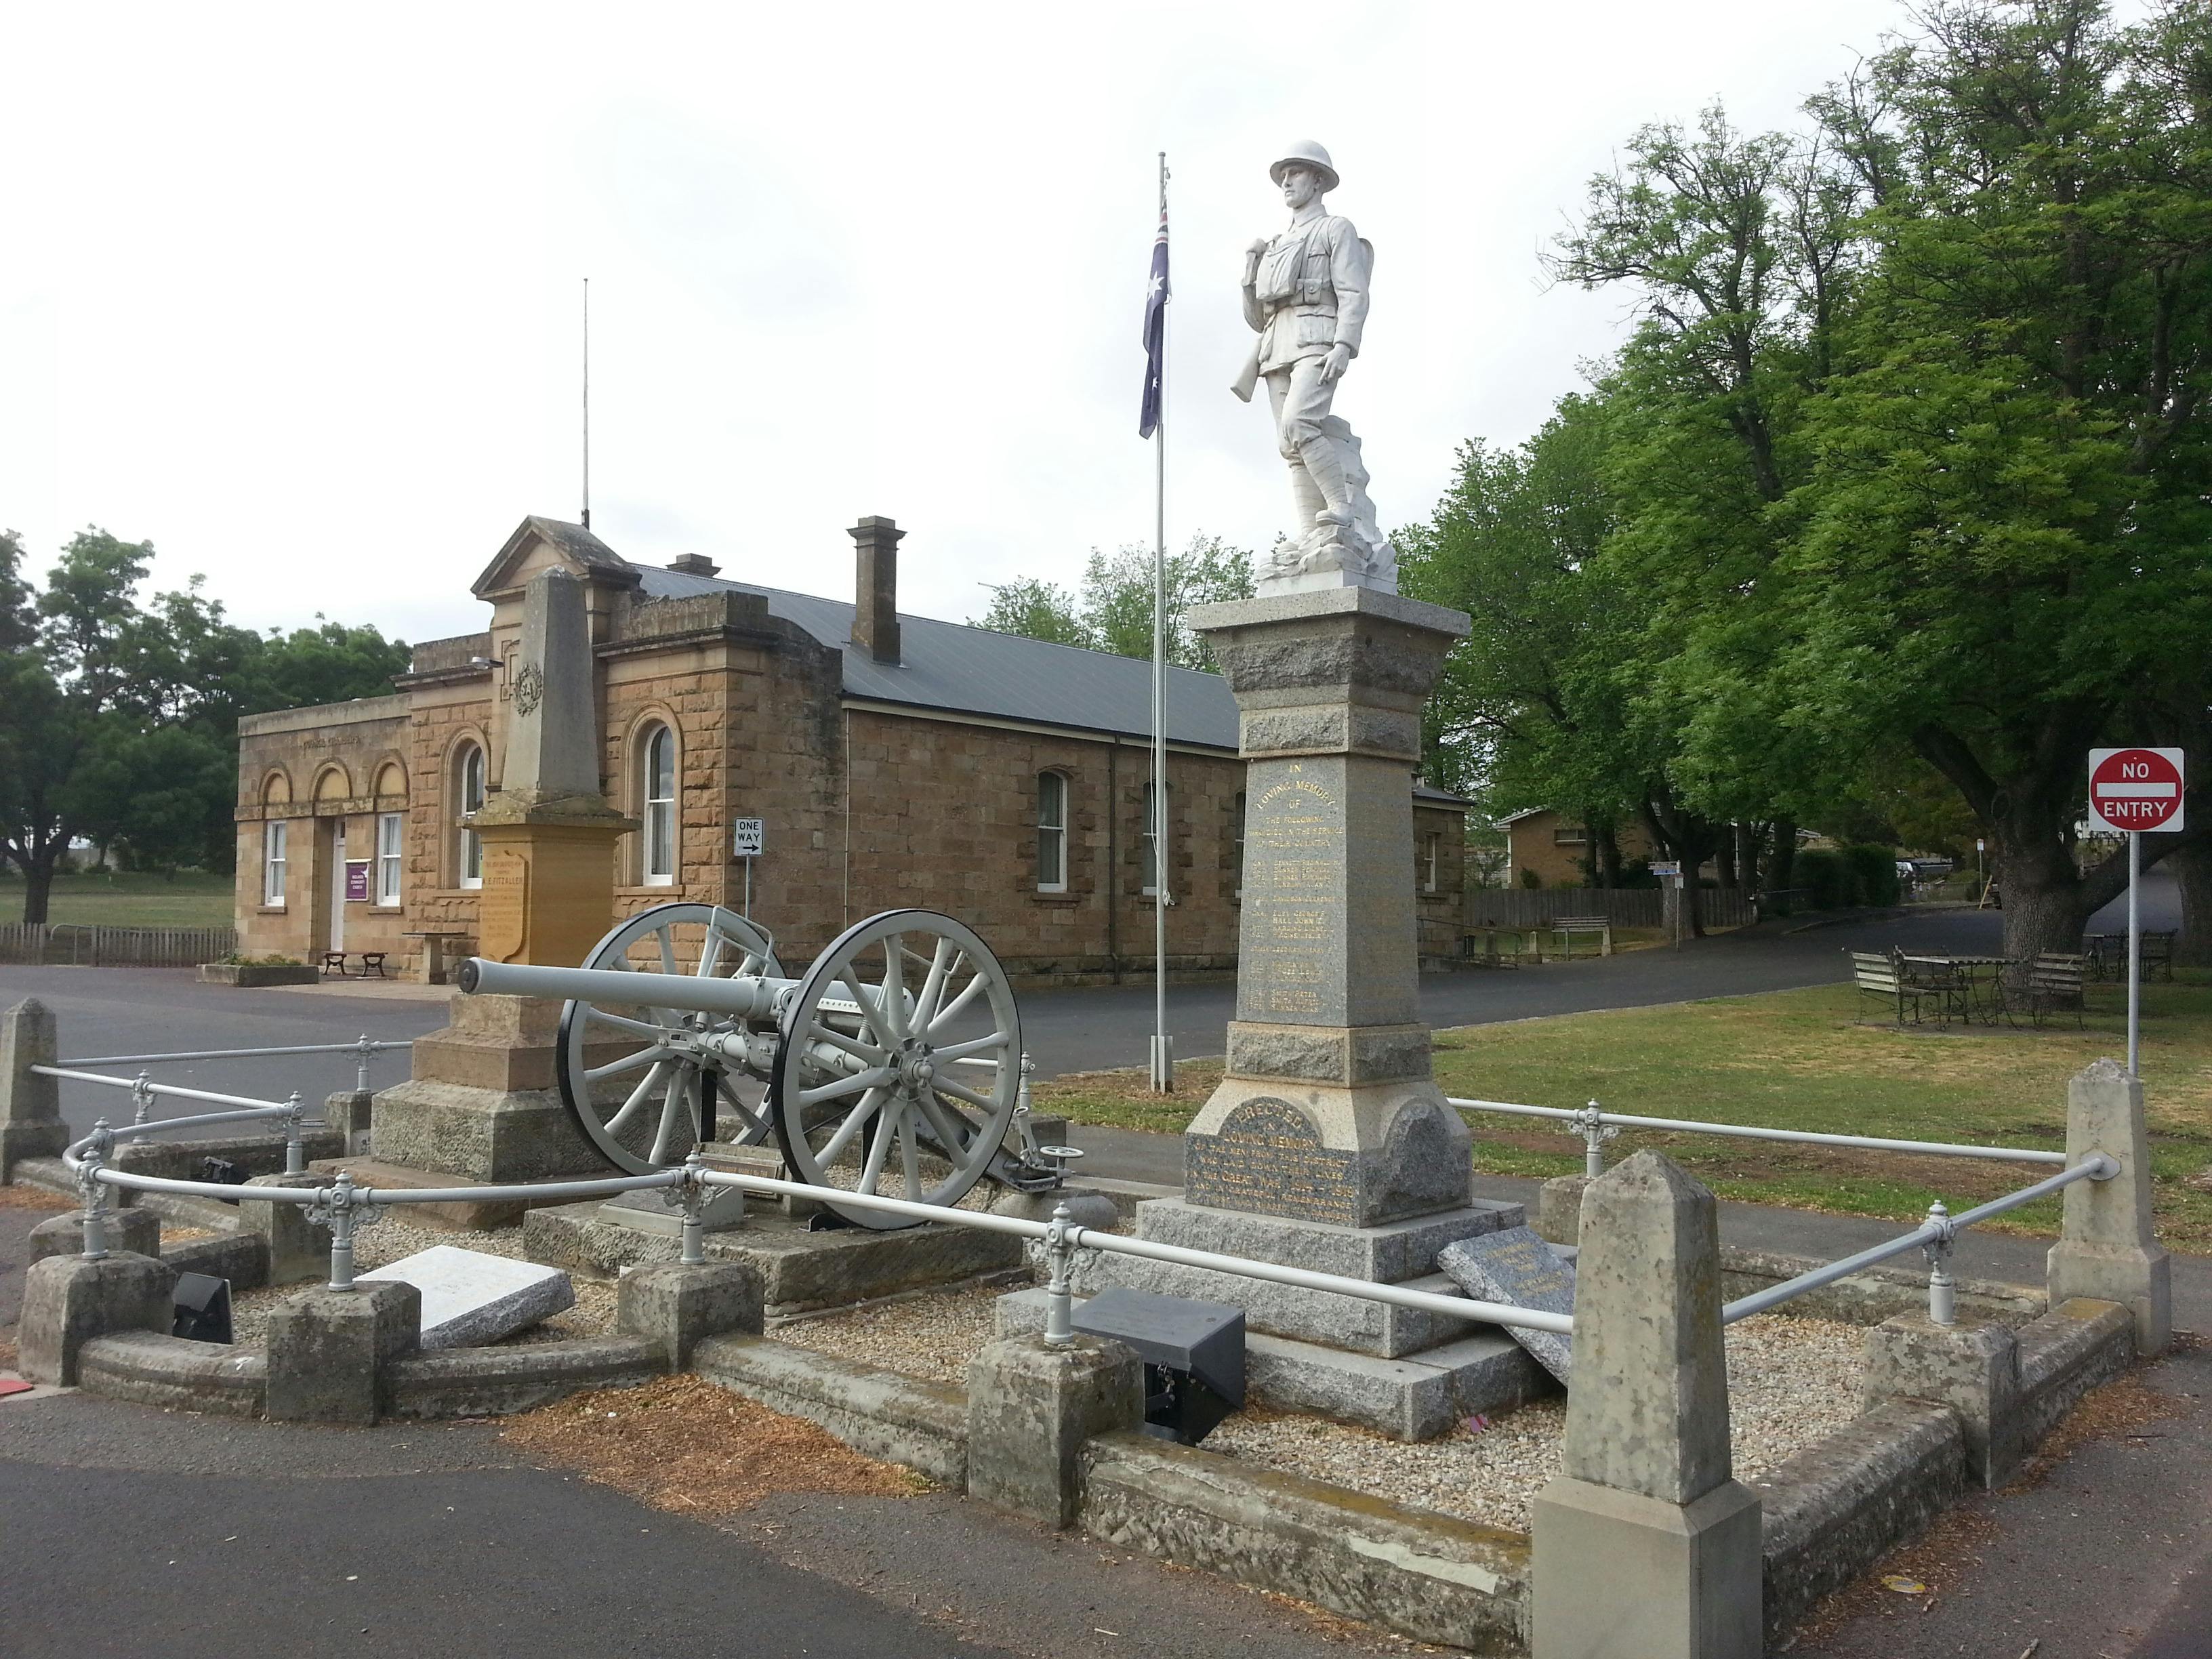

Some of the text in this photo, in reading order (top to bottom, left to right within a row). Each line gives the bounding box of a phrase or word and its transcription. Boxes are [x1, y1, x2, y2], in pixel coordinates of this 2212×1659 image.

[1289, 764, 1301, 773] IN
[2122, 762, 2149, 779] NO
[1256, 780, 1336, 809] LOVING MEMORY
[1288, 799, 1301, 808] OF
[2104, 802, 2168, 817] ENTRY
[739, 821, 759, 830] ONE
[1284, 815, 1324, 824] FOLLOWING
[737, 833, 760, 842] WAY
[1312, 826, 1343, 835] SERVICE
[1236, 1103, 1303, 1128] ERECTED
[1225, 1130, 1316, 1151] LOVING MEMORY
[1210, 1145, 1226, 1153] THE
[1230, 1148, 1246, 1156] MEN
[1251, 1149, 1271, 1158] FROM
[1279, 1153, 1298, 1162] THIS
[1304, 1156, 1349, 1168] DISTRICT
[1200, 1156, 1344, 1181] WHO LAID DOWN THEIR LIVES
[1203, 1171, 1218, 1181] THE
[1222, 1170, 1253, 1185] GREAT
[1332, 1185, 1355, 1198] 1918
[1228, 1187, 1275, 1199] GRATEFUL
[1280, 1194, 1353, 1210] REMEMBRANCE
